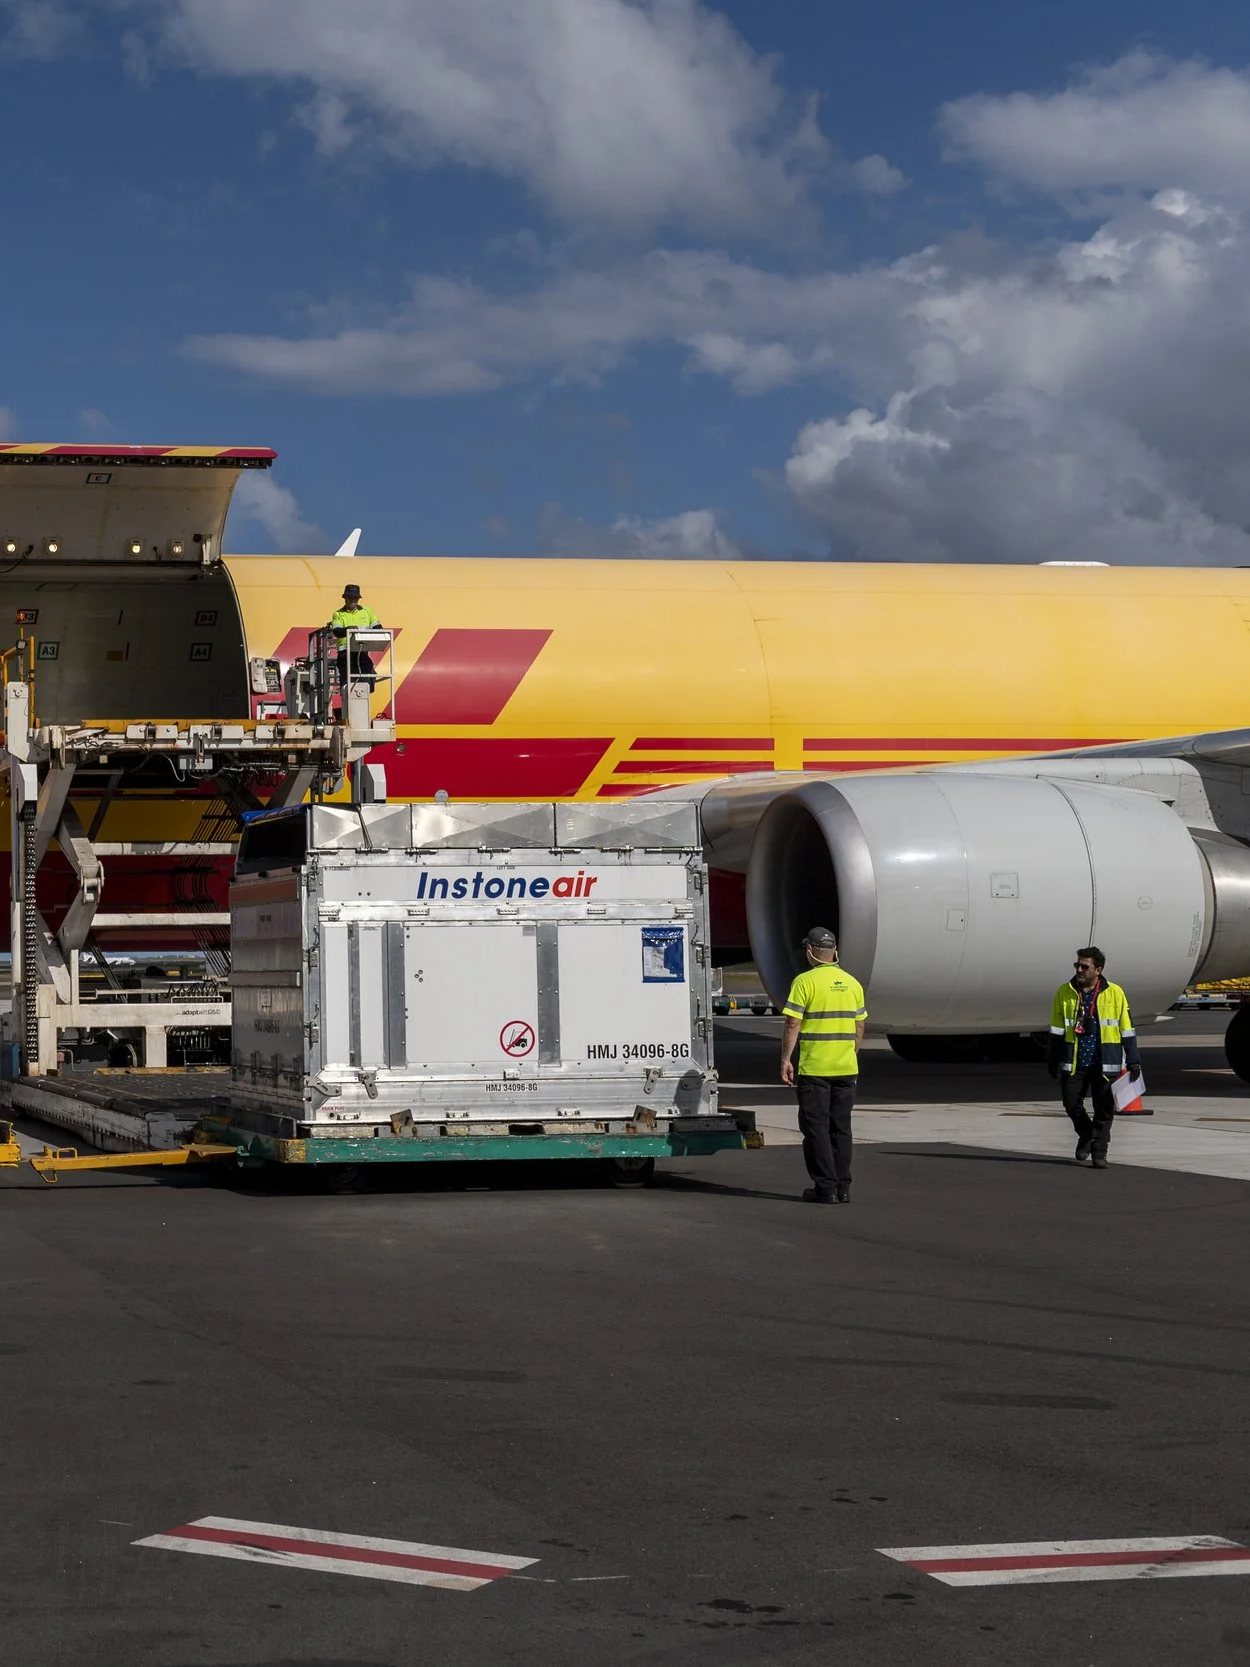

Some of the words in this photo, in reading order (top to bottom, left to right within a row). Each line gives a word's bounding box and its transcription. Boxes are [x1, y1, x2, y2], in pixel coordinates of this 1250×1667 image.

[42, 646, 55, 656] A3
[194, 647, 207, 657] A4
[587, 1045, 617, 1059] HMJ
[622, 1043, 689, 1059] 34096-8G
[485, 1083, 501, 1092] HMJ
[503, 1083, 538, 1092] 34096-8G
